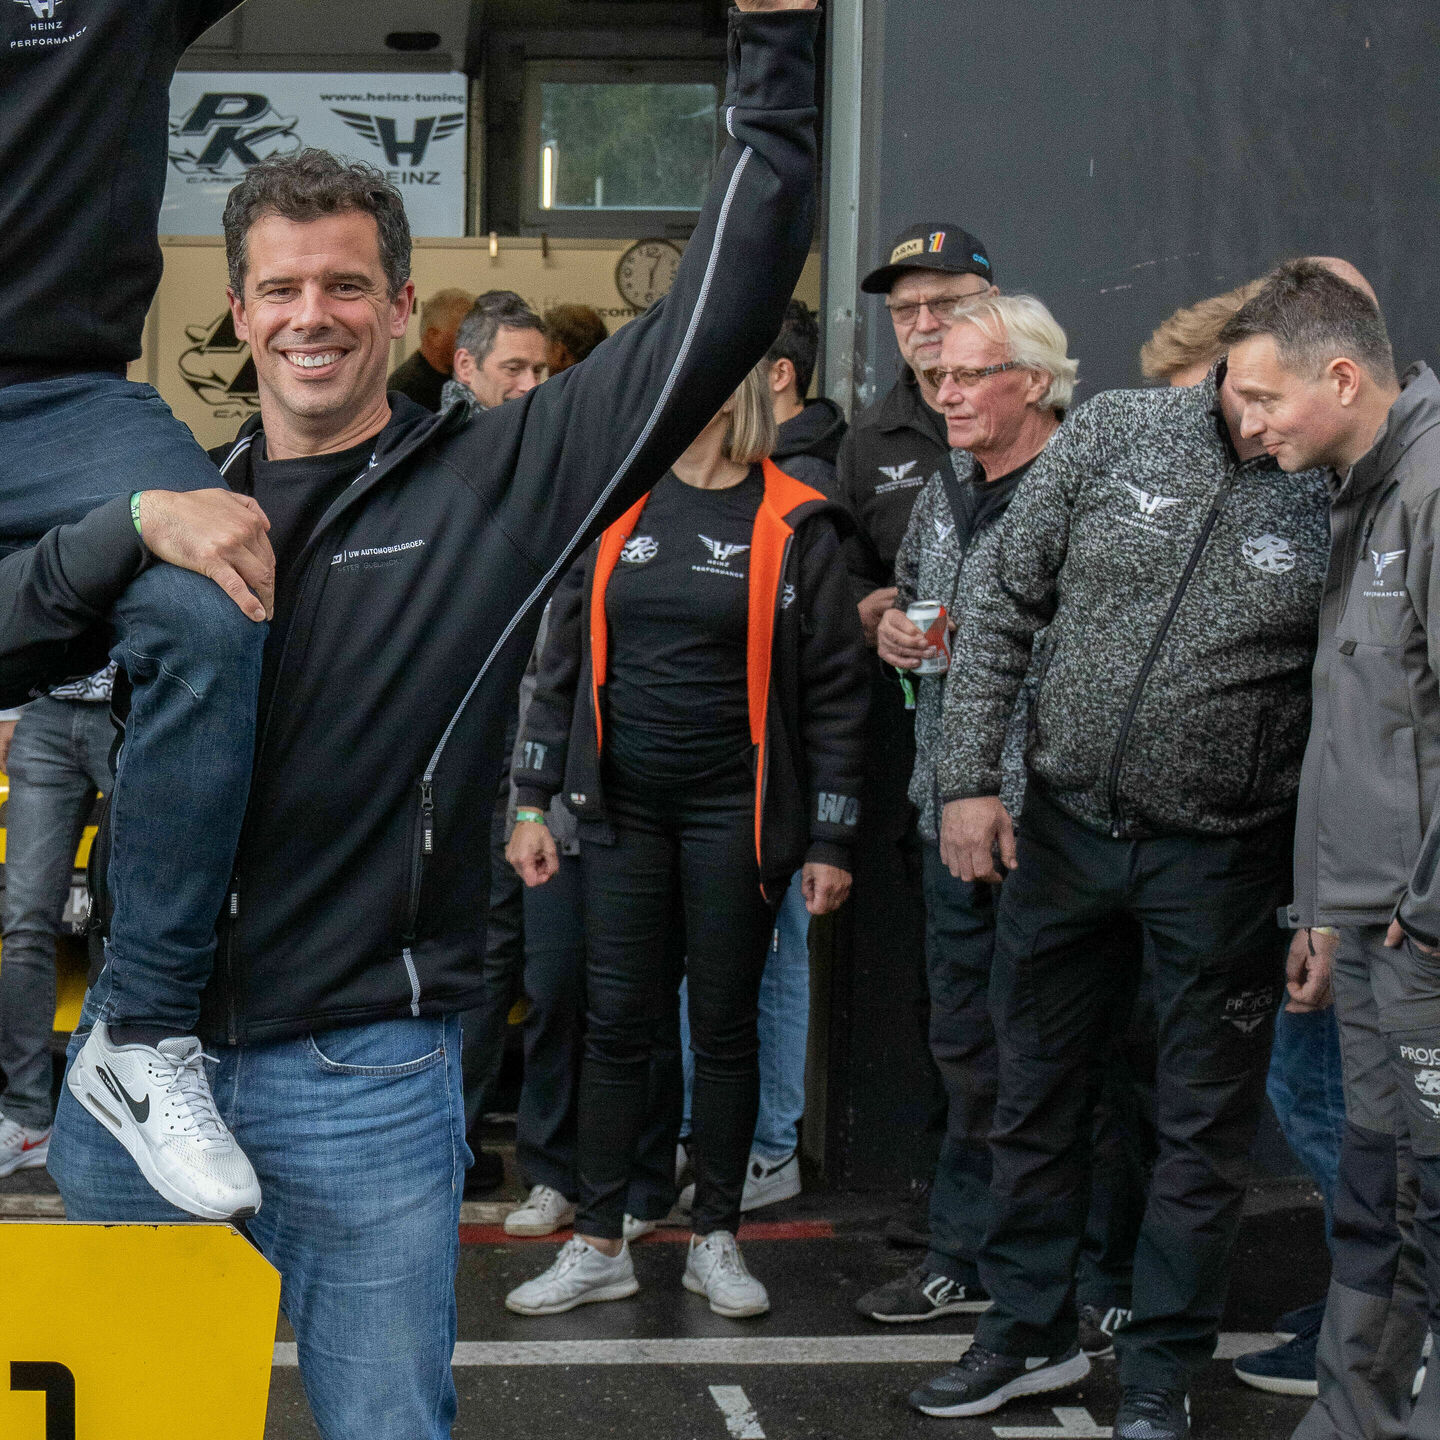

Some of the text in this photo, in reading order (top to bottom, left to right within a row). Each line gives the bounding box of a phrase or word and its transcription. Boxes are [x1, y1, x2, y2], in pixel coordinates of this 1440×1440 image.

[30, 21, 64, 32] HEINZ
[392, 171, 441, 186] EINZ
[348, 550, 360, 559] UW
